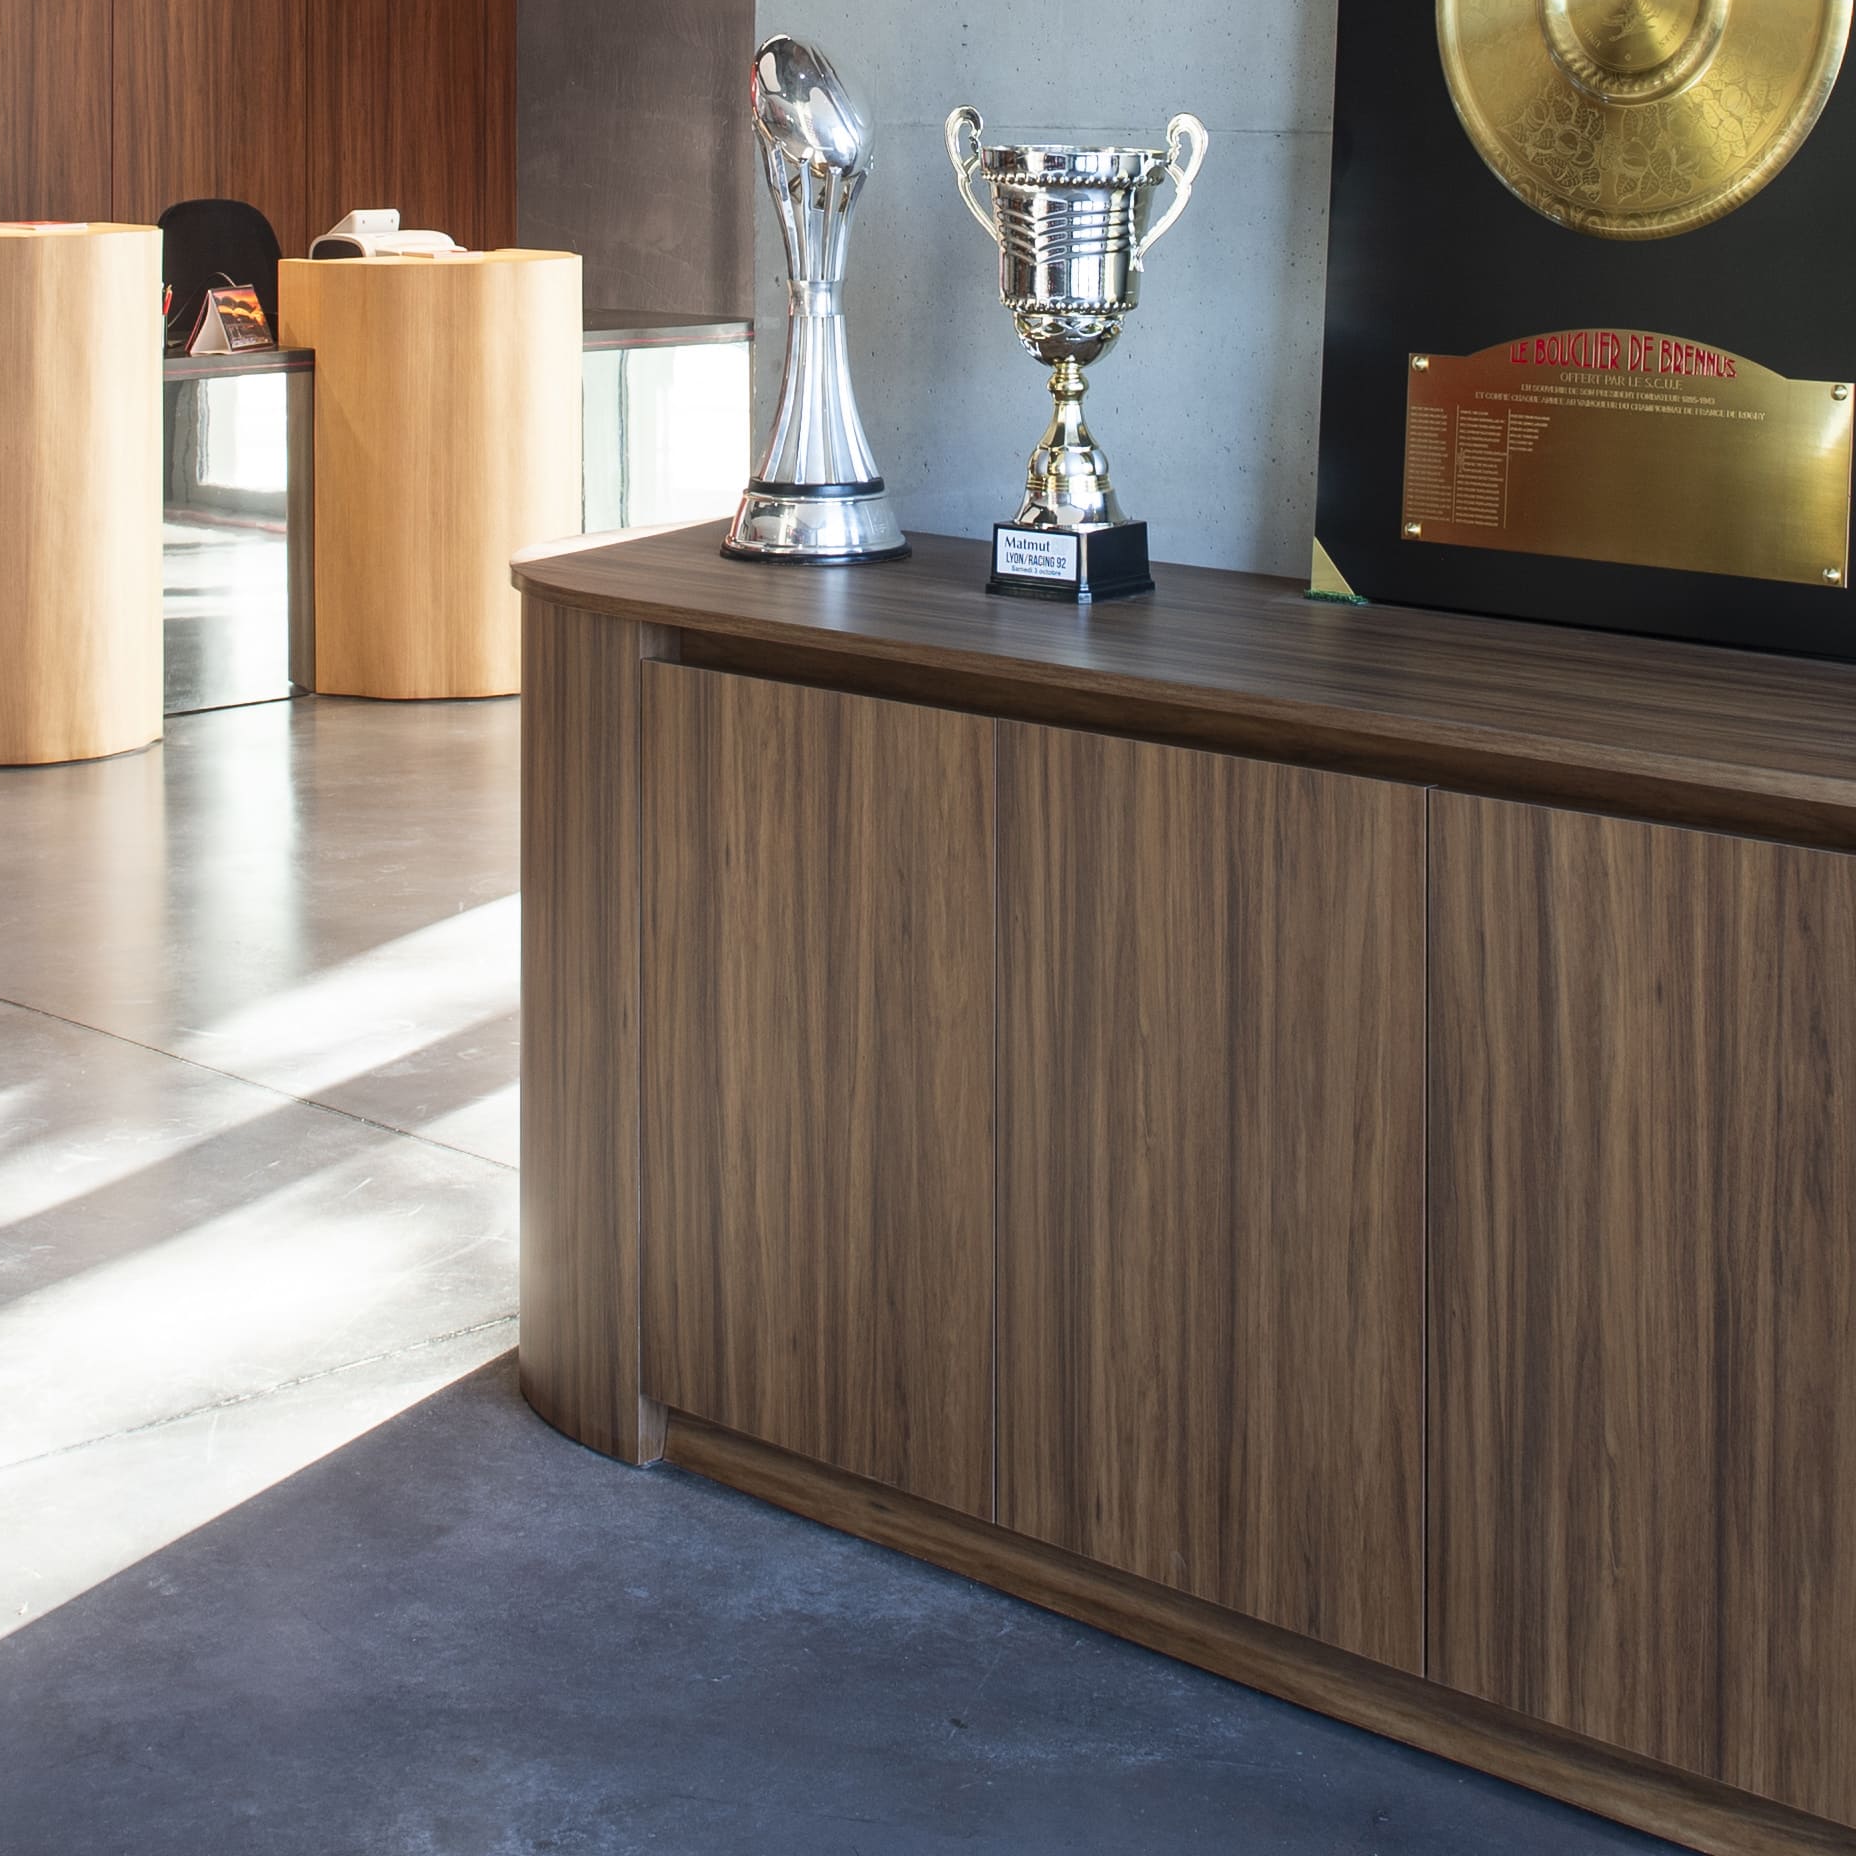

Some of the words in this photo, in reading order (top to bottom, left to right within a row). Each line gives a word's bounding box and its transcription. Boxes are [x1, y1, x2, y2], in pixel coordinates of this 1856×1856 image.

[1510, 341, 1529, 364] LE
[1534, 331, 1620, 370] BOUCLIER
[1628, 334, 1654, 373] DE
[1659, 339, 1738, 379] BRENNUS
[1560, 372, 1601, 385] OFFERT
[1604, 375, 1625, 386] PAR
[1004, 536, 1050, 552] Matmut
[1006, 552, 1055, 567] LYON/RACING
[1056, 557, 1067, 569] 92
